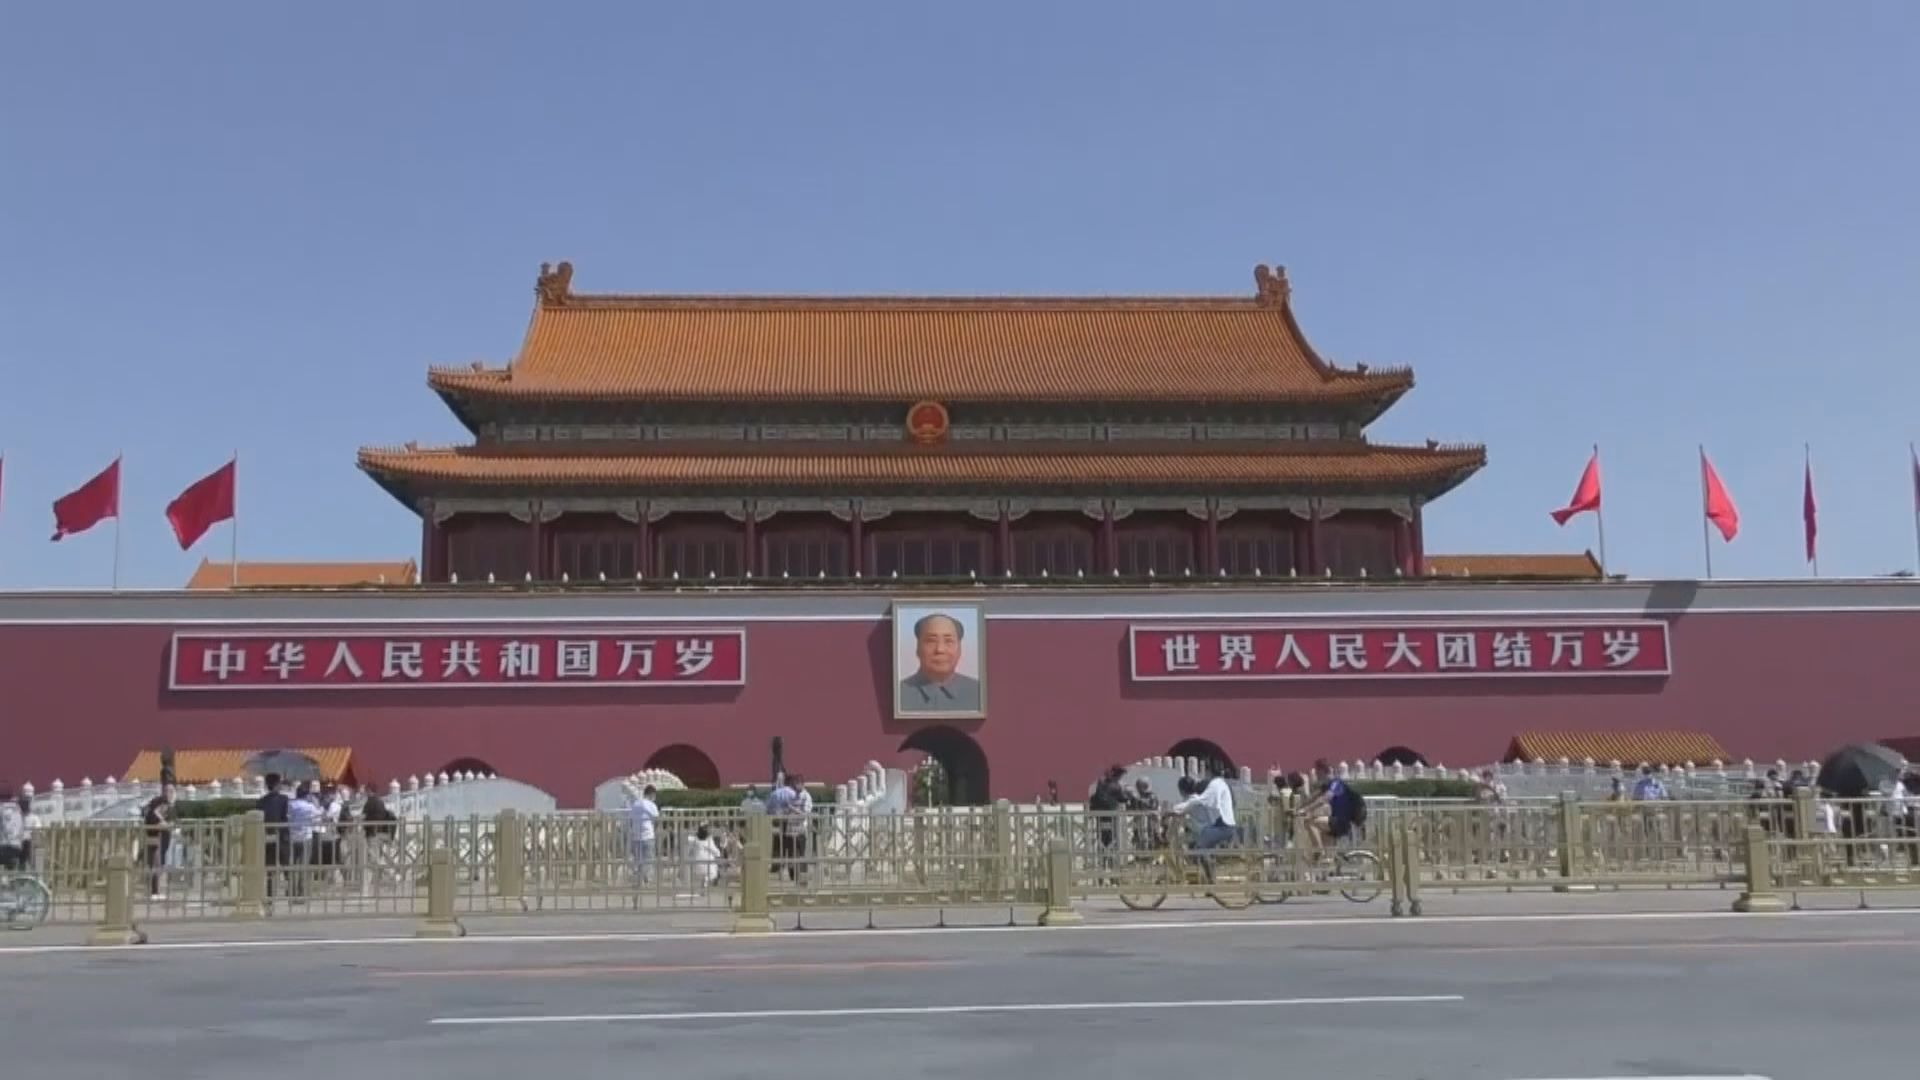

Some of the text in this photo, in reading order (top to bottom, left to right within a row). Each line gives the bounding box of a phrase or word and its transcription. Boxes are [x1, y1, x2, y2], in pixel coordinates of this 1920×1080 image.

[202, 639, 715, 679] 中华人民共和国万岁
[1161, 630, 1641, 672] 世界人民大团结万岁
